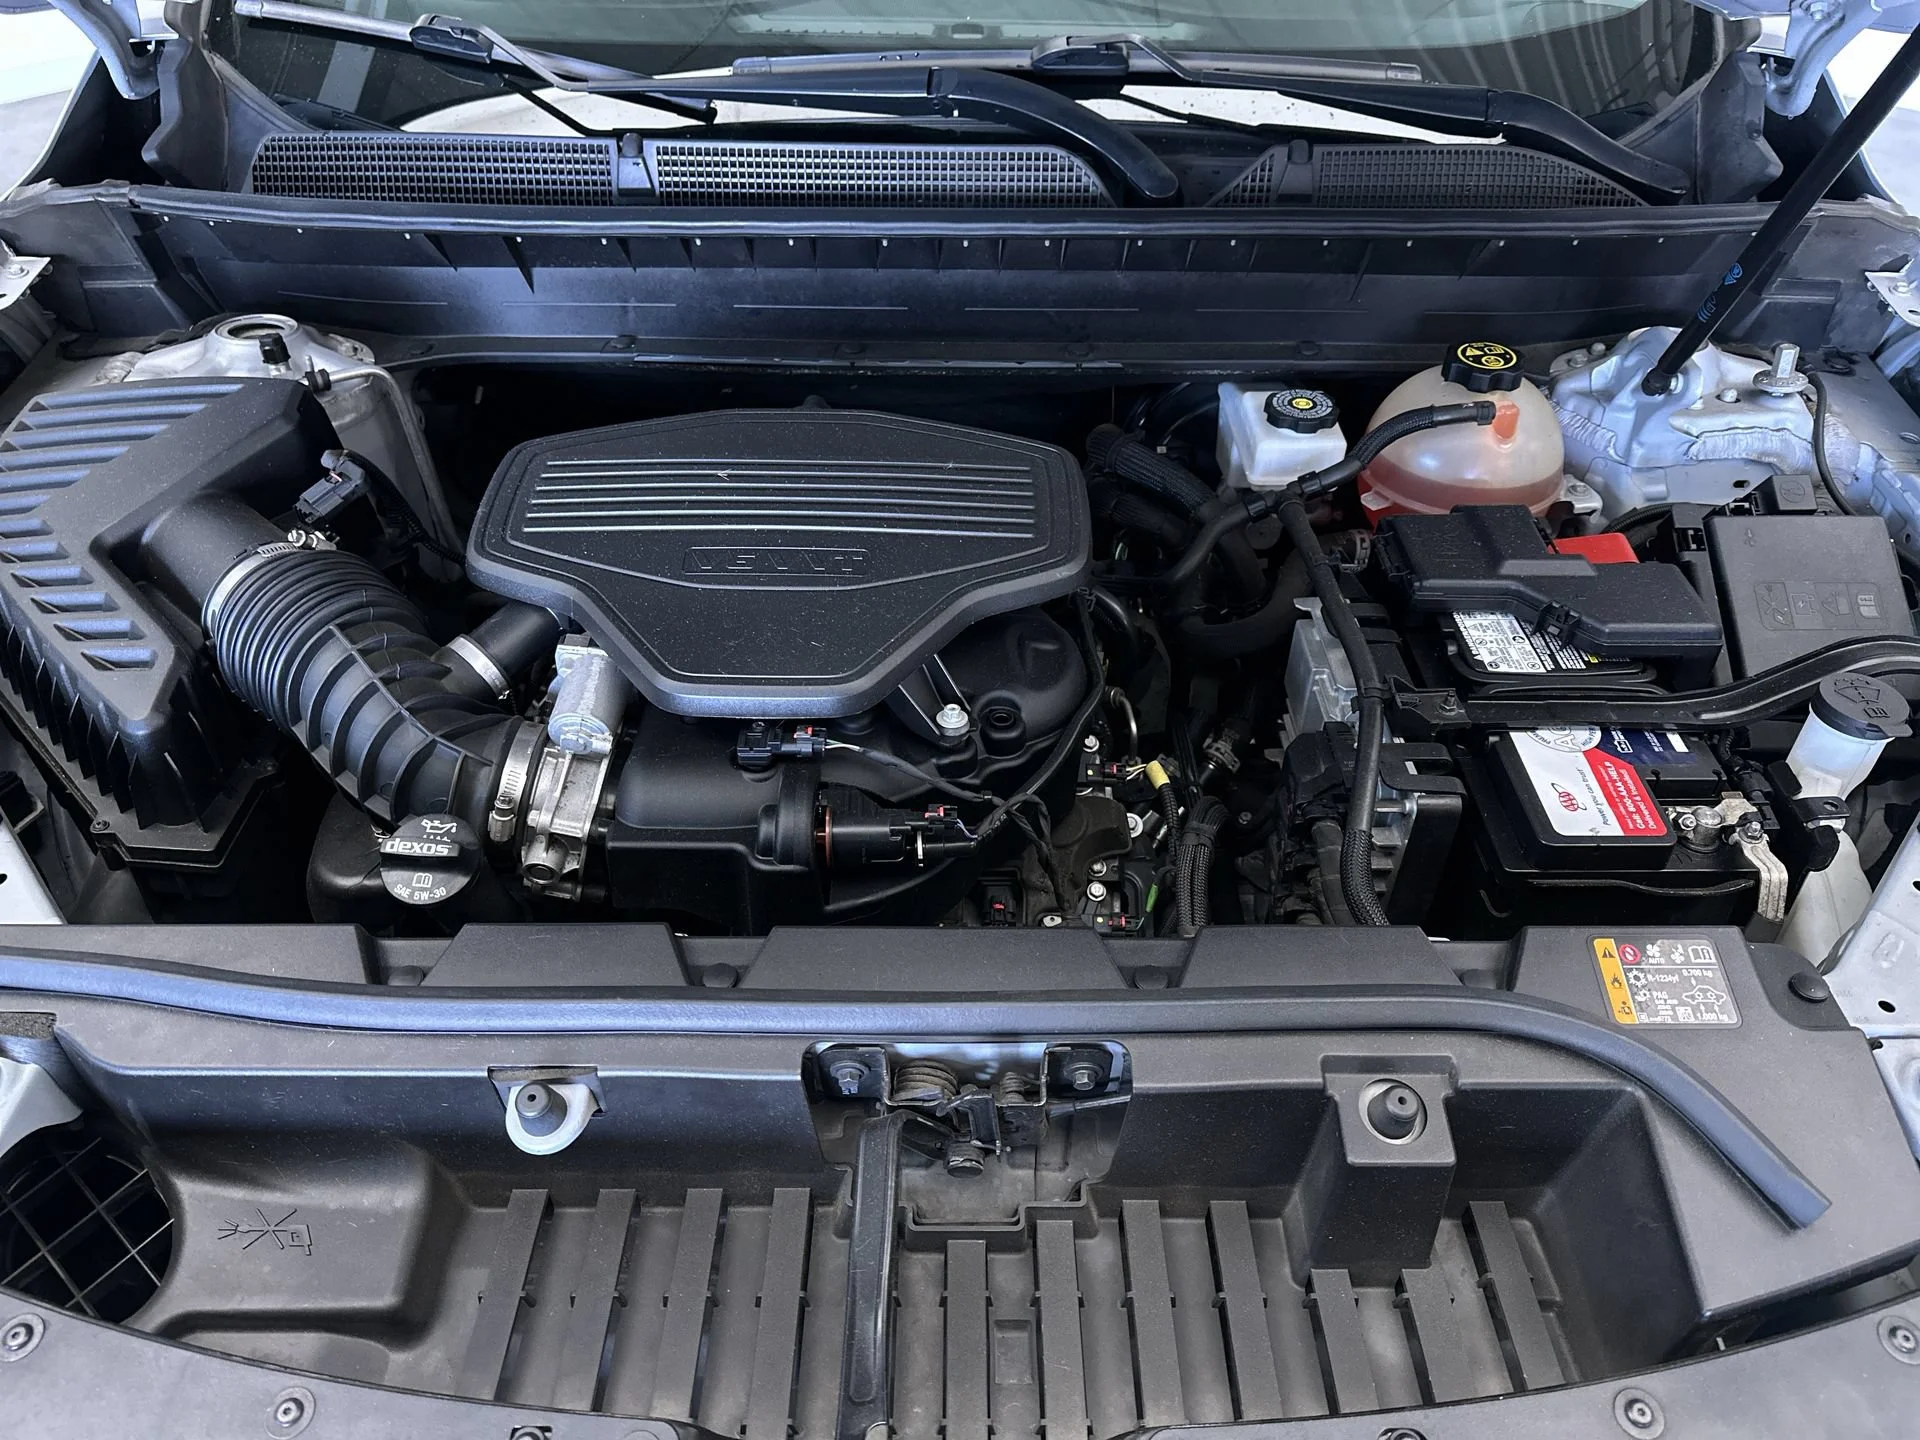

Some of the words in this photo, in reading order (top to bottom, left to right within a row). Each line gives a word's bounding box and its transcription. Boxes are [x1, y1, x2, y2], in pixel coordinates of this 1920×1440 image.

[385, 837, 453, 856] dexos
[394, 883, 412, 899] SAE
[413, 886, 447, 901] 5W-30
[1702, 968, 1713, 978] kg
